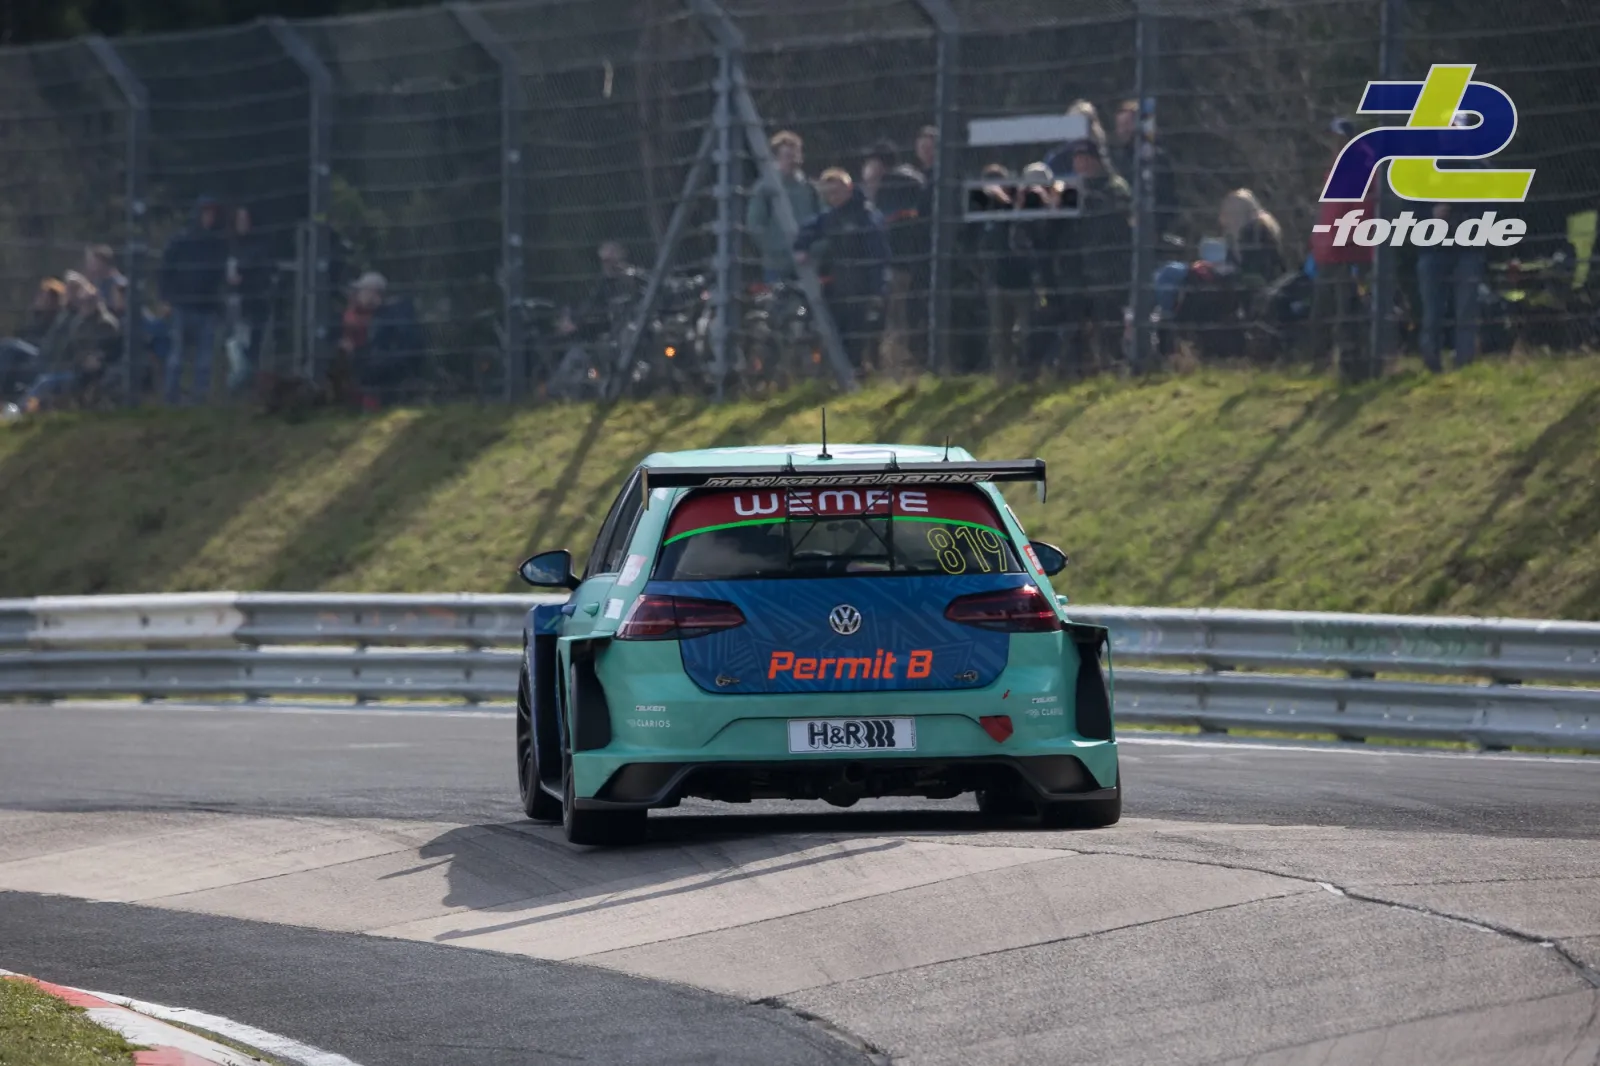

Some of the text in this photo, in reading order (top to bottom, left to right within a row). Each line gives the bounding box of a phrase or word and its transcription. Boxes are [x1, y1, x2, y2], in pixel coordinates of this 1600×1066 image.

[704, 476, 776, 487] MAX
[878, 472, 992, 484] RACING
[733, 490, 928, 516] WEMPE
[927, 526, 1007, 574] 819
[768, 648, 933, 680] Permit B
[637, 719, 671, 728] CLARIOS
[808, 721, 867, 749] H&R
